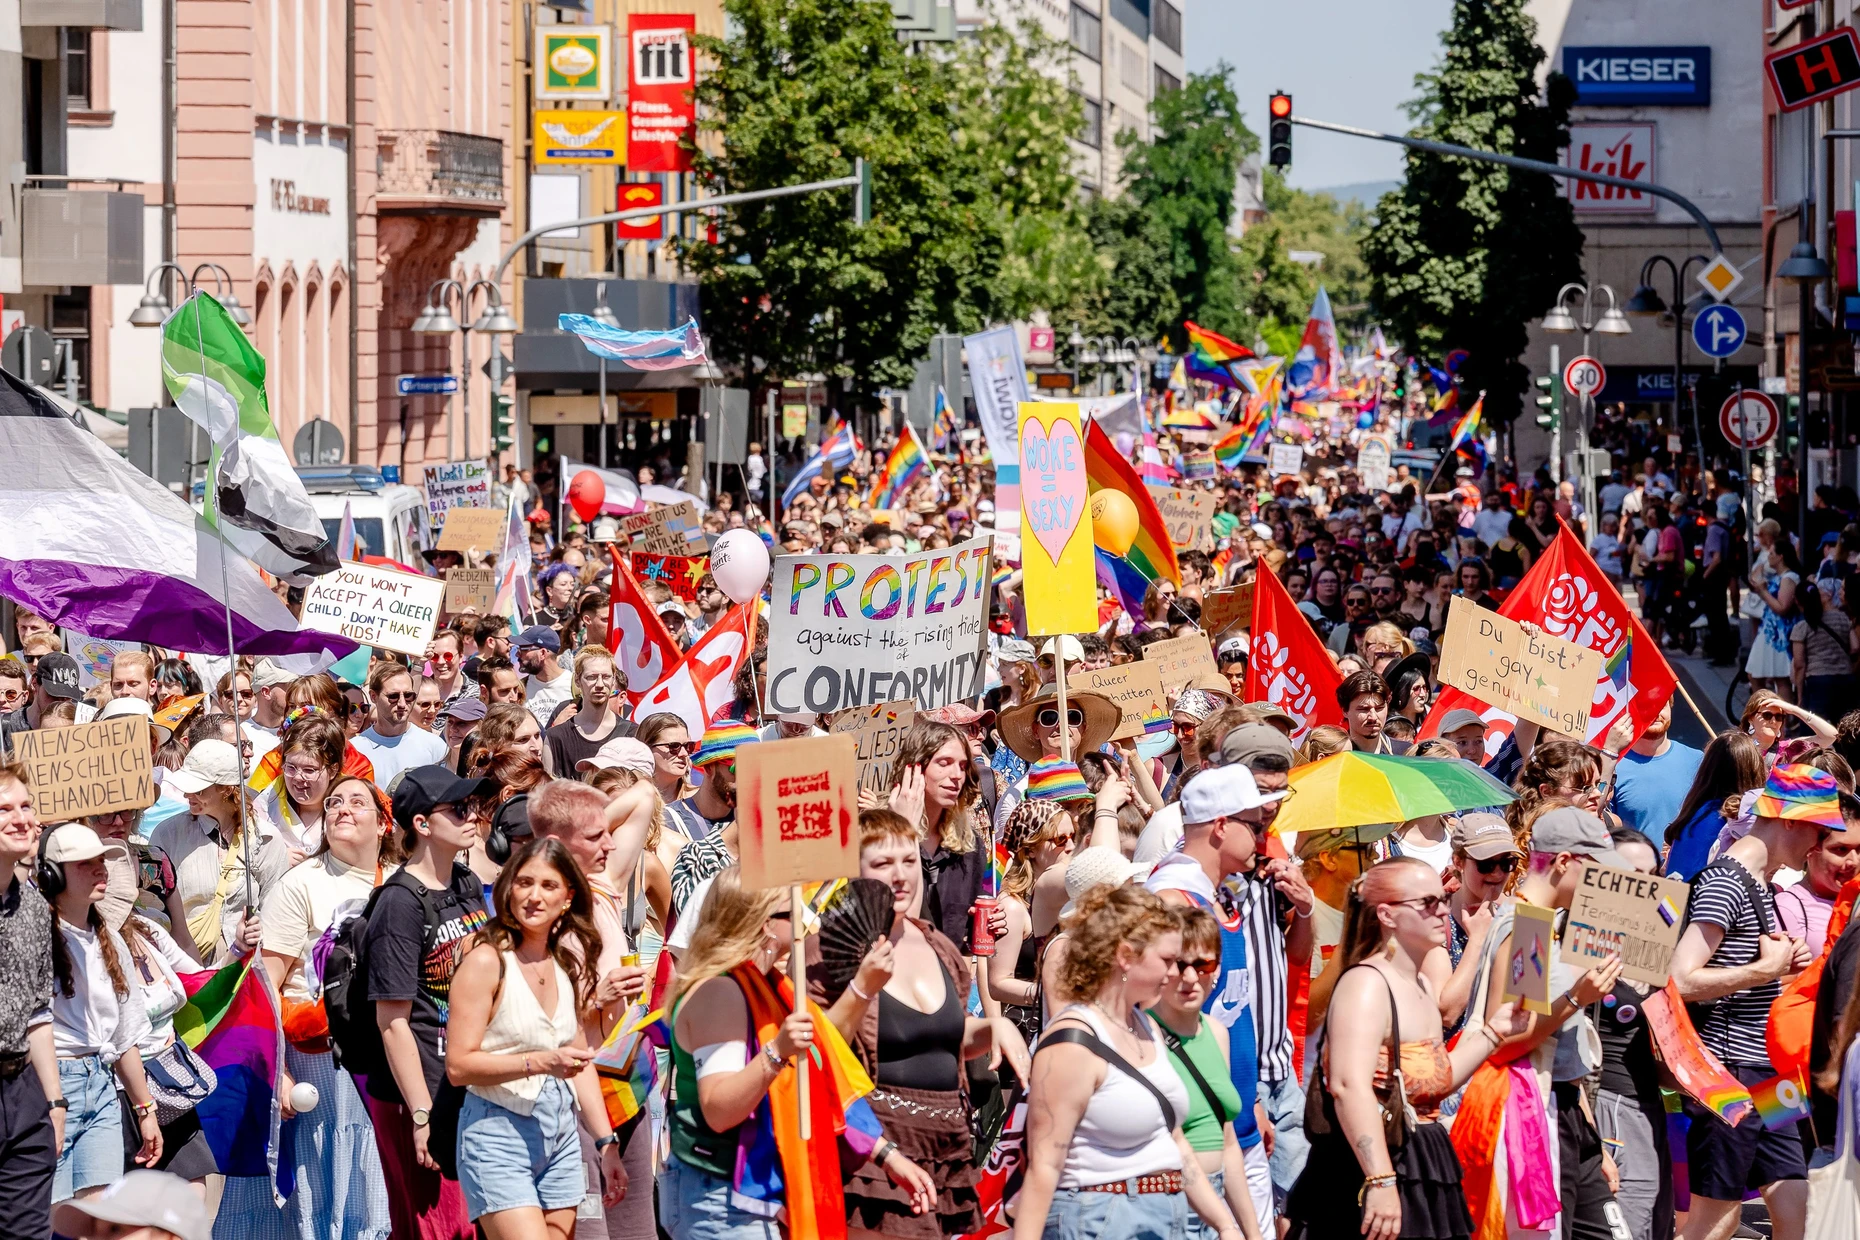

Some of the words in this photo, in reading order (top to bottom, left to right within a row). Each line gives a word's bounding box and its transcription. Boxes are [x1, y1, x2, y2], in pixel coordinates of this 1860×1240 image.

[639, 43, 684, 78] fit
[1577, 57, 1696, 82] KIESER
[1795, 45, 1842, 93] H
[1575, 368, 1597, 387] 30
[1023, 436, 1076, 473] WOKE
[626, 513, 652, 531] NONE
[673, 504, 688, 517] US
[1031, 495, 1075, 532] SEXY
[643, 537, 669, 552] UNTIL
[669, 532, 685, 547] WE
[644, 524, 663, 540] ARE
[451, 570, 490, 583] MEDIZIN
[669, 558, 686, 569] BE
[335, 570, 364, 584] YOU
[371, 577, 412, 597] WON'T
[790, 547, 991, 620] PROTEST
[312, 585, 368, 607] ACCEPT
[372, 597, 384, 611] A
[389, 600, 433, 622] QUEER
[340, 623, 381, 643] KIDS!
[350, 611, 388, 628] DON'T
[389, 620, 422, 639] HAVE
[796, 627, 873, 655] against
[879, 629, 910, 651] the
[914, 624, 954, 650] rising
[957, 614, 985, 637] tide
[1479, 619, 1503, 644] Du
[1158, 654, 1210, 675] EGENBOGEN
[1528, 638, 1567, 670] bist
[770, 650, 985, 714] CONFORMITY
[1495, 656, 1533, 684] gay
[19, 720, 137, 759] MENSCHEN
[1583, 867, 1659, 900] ECHTER
